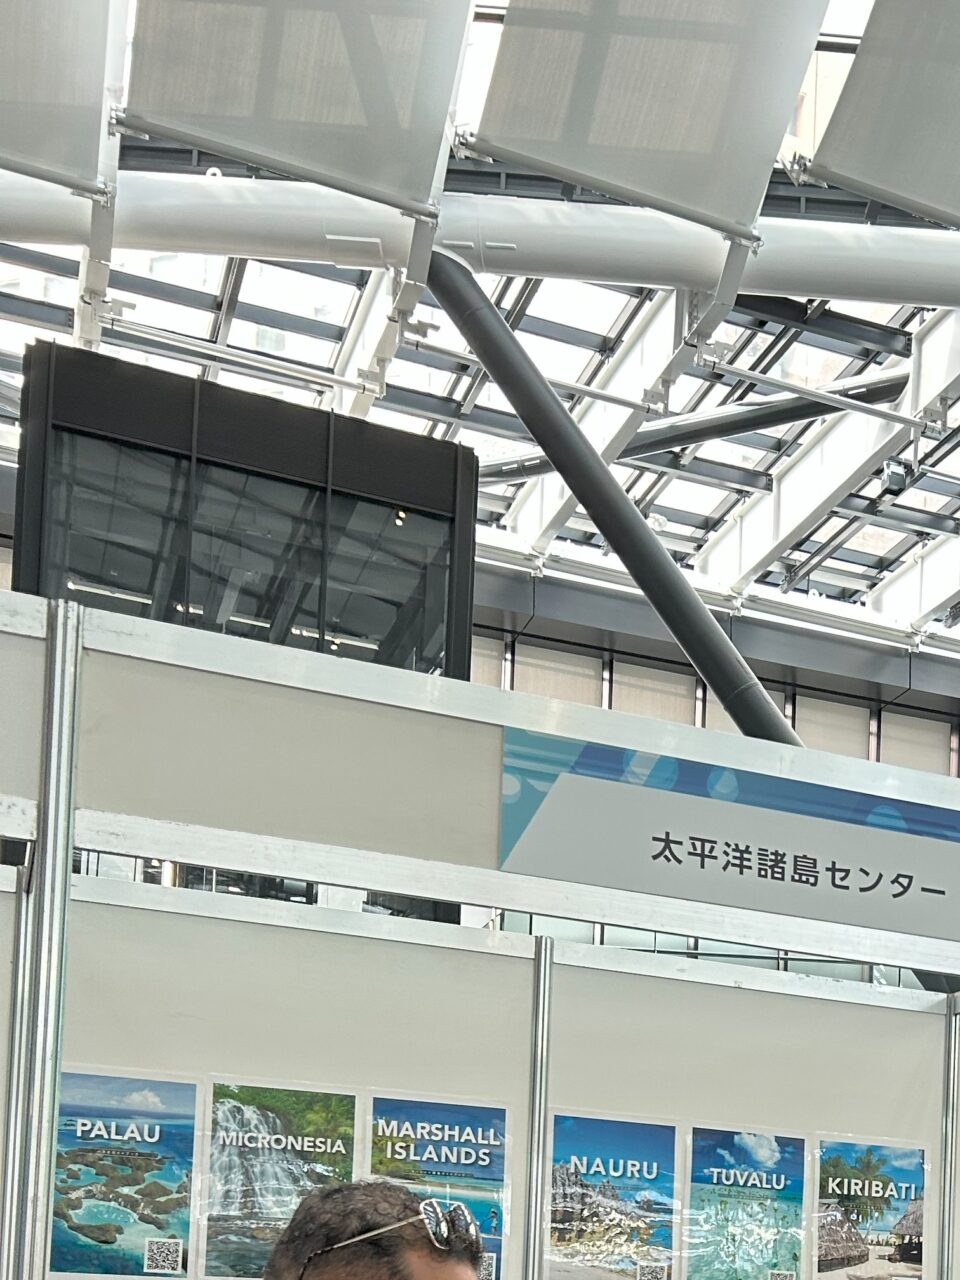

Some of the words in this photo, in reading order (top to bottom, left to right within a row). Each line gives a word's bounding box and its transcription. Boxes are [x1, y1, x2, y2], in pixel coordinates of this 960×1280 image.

[651, 831, 946, 899] 太平洋諸島センター
[76, 1119, 161, 1143] PALAU
[219, 1131, 346, 1155] MICRONESIA
[378, 1119, 501, 1146] MARSHALL
[386, 1143, 491, 1167] ISLANDS
[570, 1155, 658, 1180] NAURU
[710, 1168, 786, 1191] TUVALU
[828, 1177, 916, 1200] KIRIBATI
